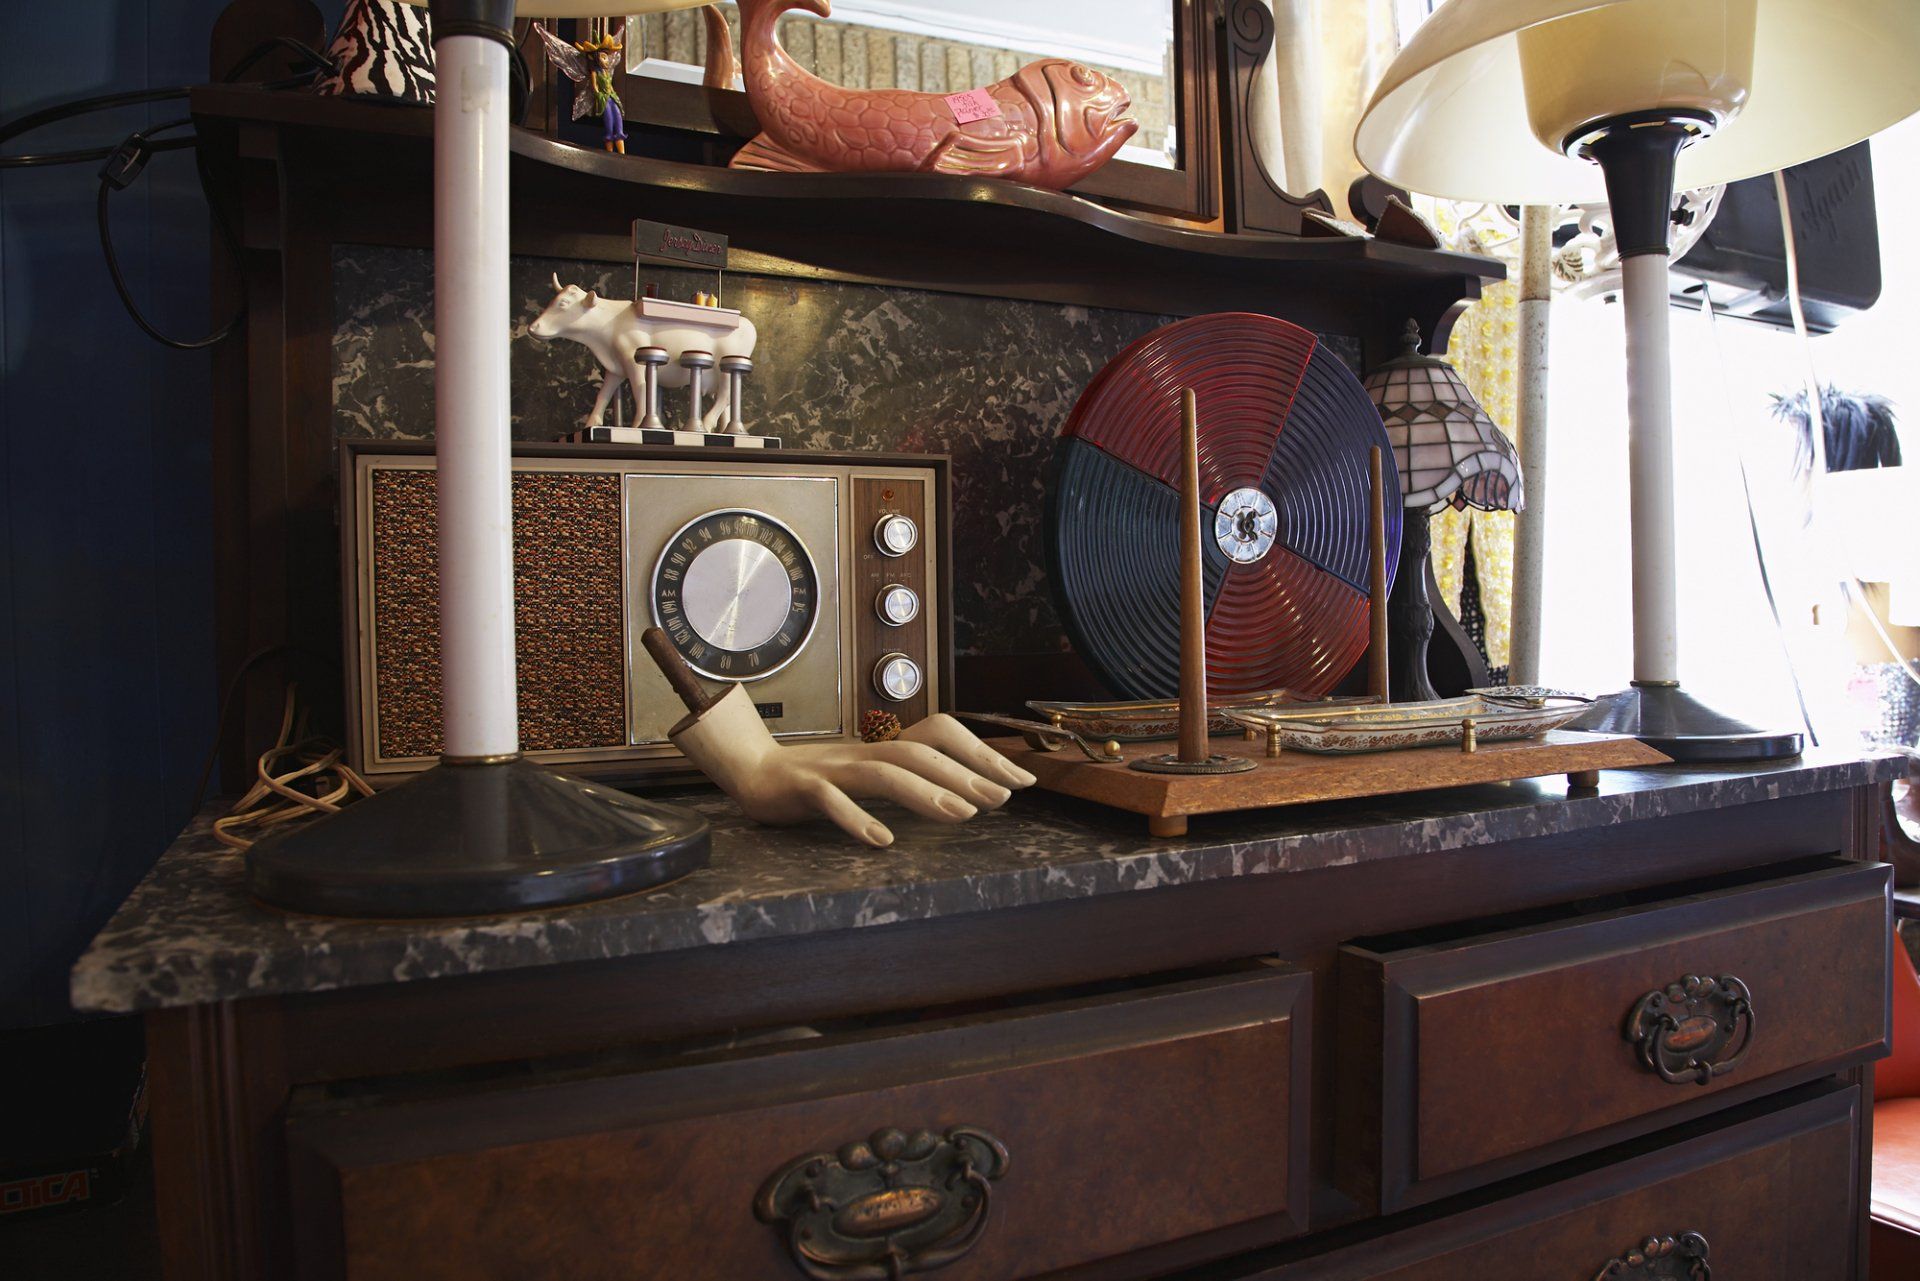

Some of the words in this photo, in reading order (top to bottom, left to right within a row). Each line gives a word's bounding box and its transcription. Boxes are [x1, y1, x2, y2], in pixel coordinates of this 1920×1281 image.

[698, 526, 712, 541] 94
[719, 521, 731, 535] 96
[759, 528, 774, 544] 102
[681, 538, 697, 553] 92
[670, 552, 686, 567] 90
[663, 568, 680, 581] 88
[793, 587, 806, 595] FM
[661, 600, 678, 614] 160
[666, 615, 683, 631] 140
[674, 628, 691, 645] 120
[777, 631, 792, 647] 60
[688, 642, 706, 660] 100
[720, 654, 732, 670] 80
[748, 651, 760, 668] 70
